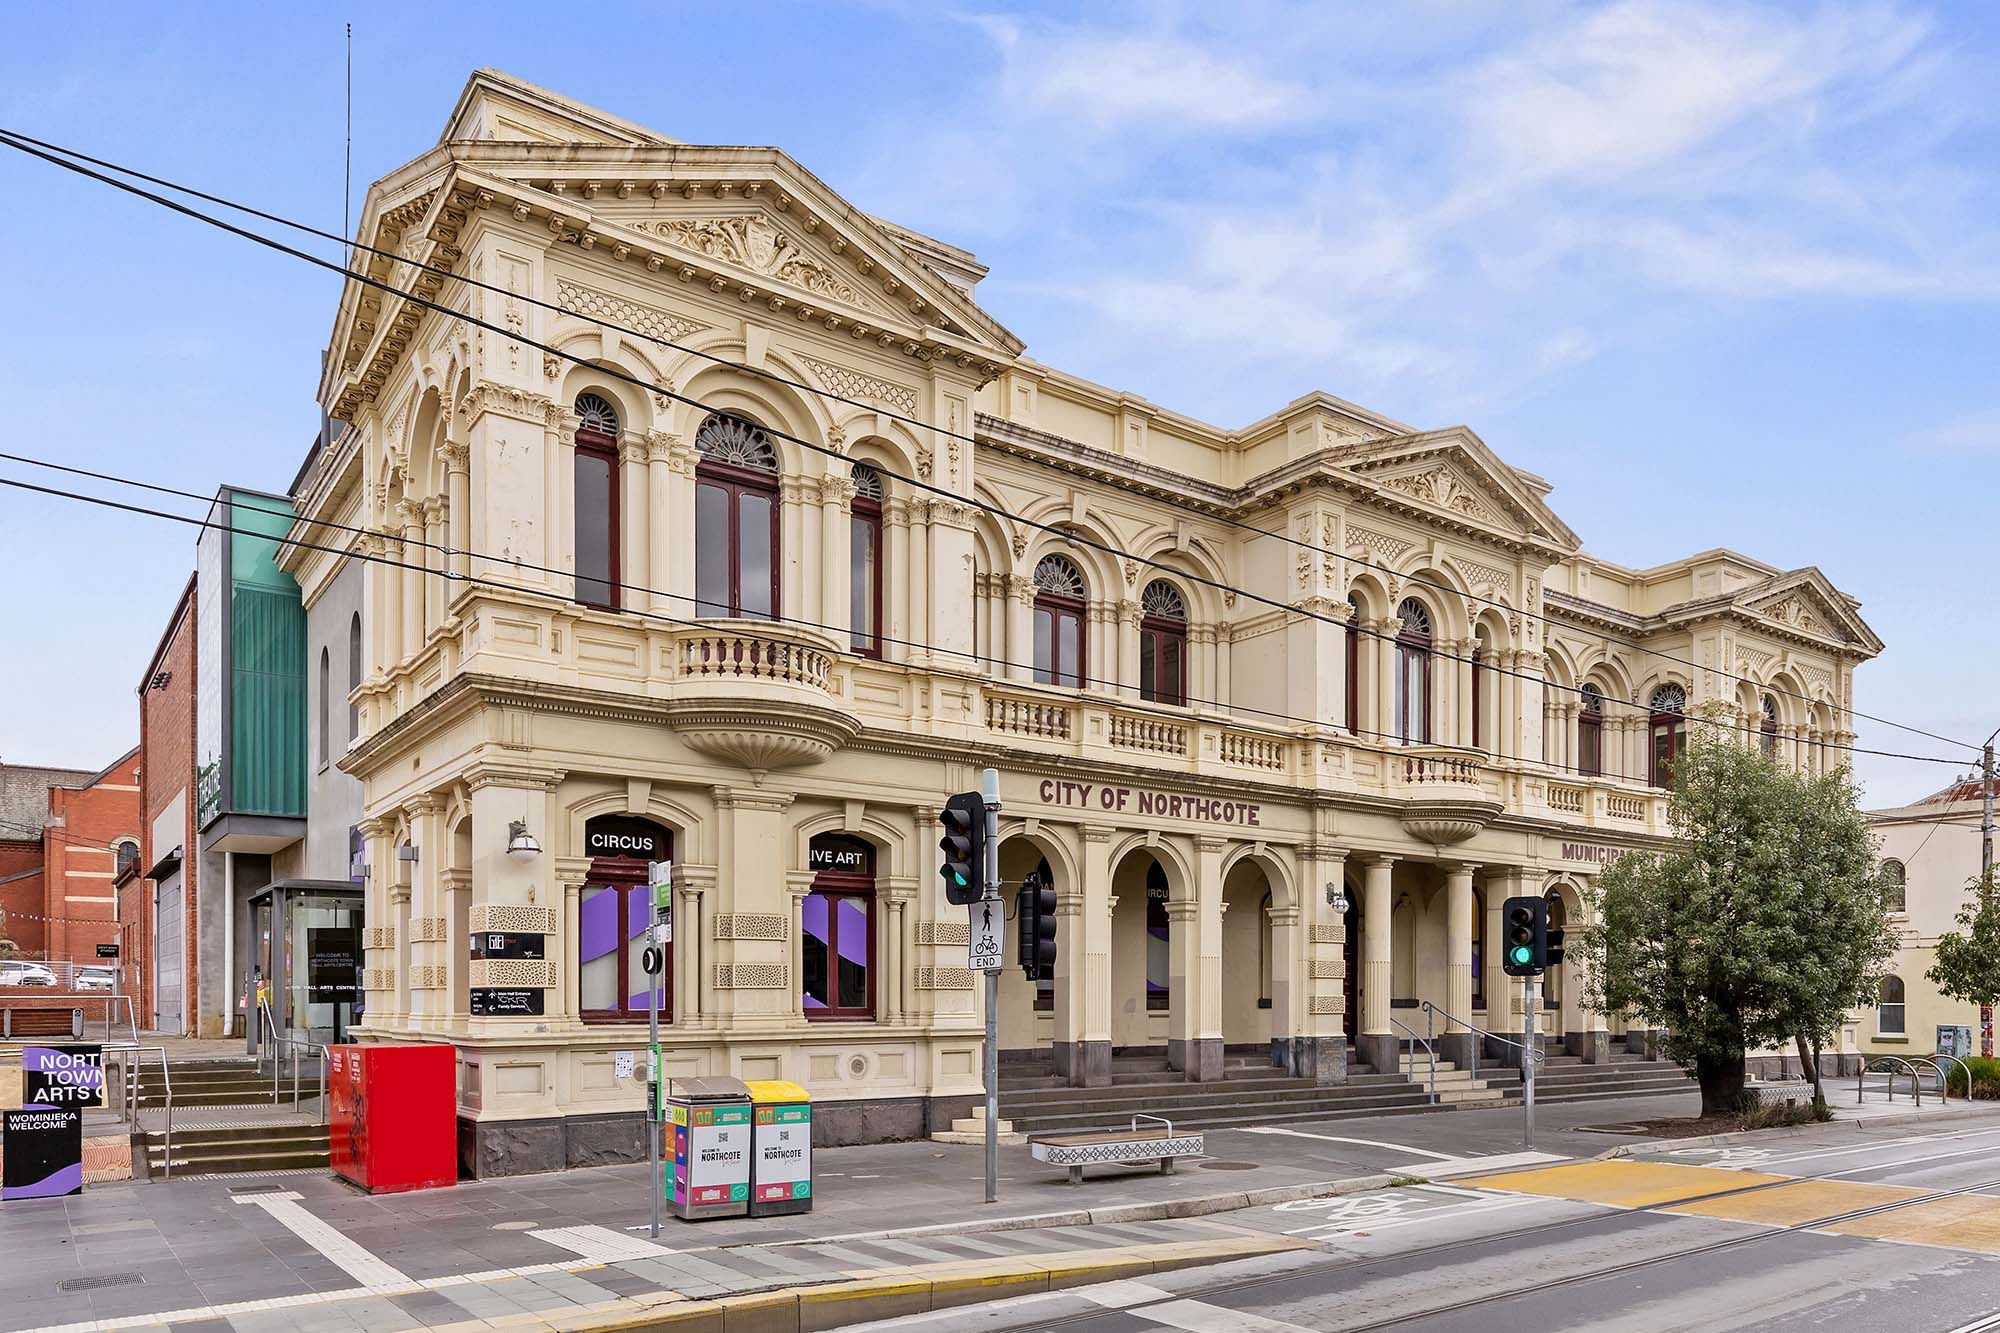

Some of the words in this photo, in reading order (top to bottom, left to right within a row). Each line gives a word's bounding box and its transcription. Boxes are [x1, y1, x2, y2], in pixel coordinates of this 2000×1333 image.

[1039, 779, 1093, 807] CITY
[1100, 787, 1130, 811] OF
[1138, 791, 1260, 826] NORTHCOTE
[591, 833, 653, 851] CIRCUS
[809, 849, 833, 863] IVE
[835, 851, 863, 865] ART
[976, 957, 995, 967] END
[33, 1086, 90, 1103] ARTS
[9, 1112, 77, 1123] WOMINJEKA
[9, 1121, 67, 1131] WELCOME
[701, 1151, 741, 1162] NORTHCOTE
[764, 1149, 802, 1160] NORTHCOTE
